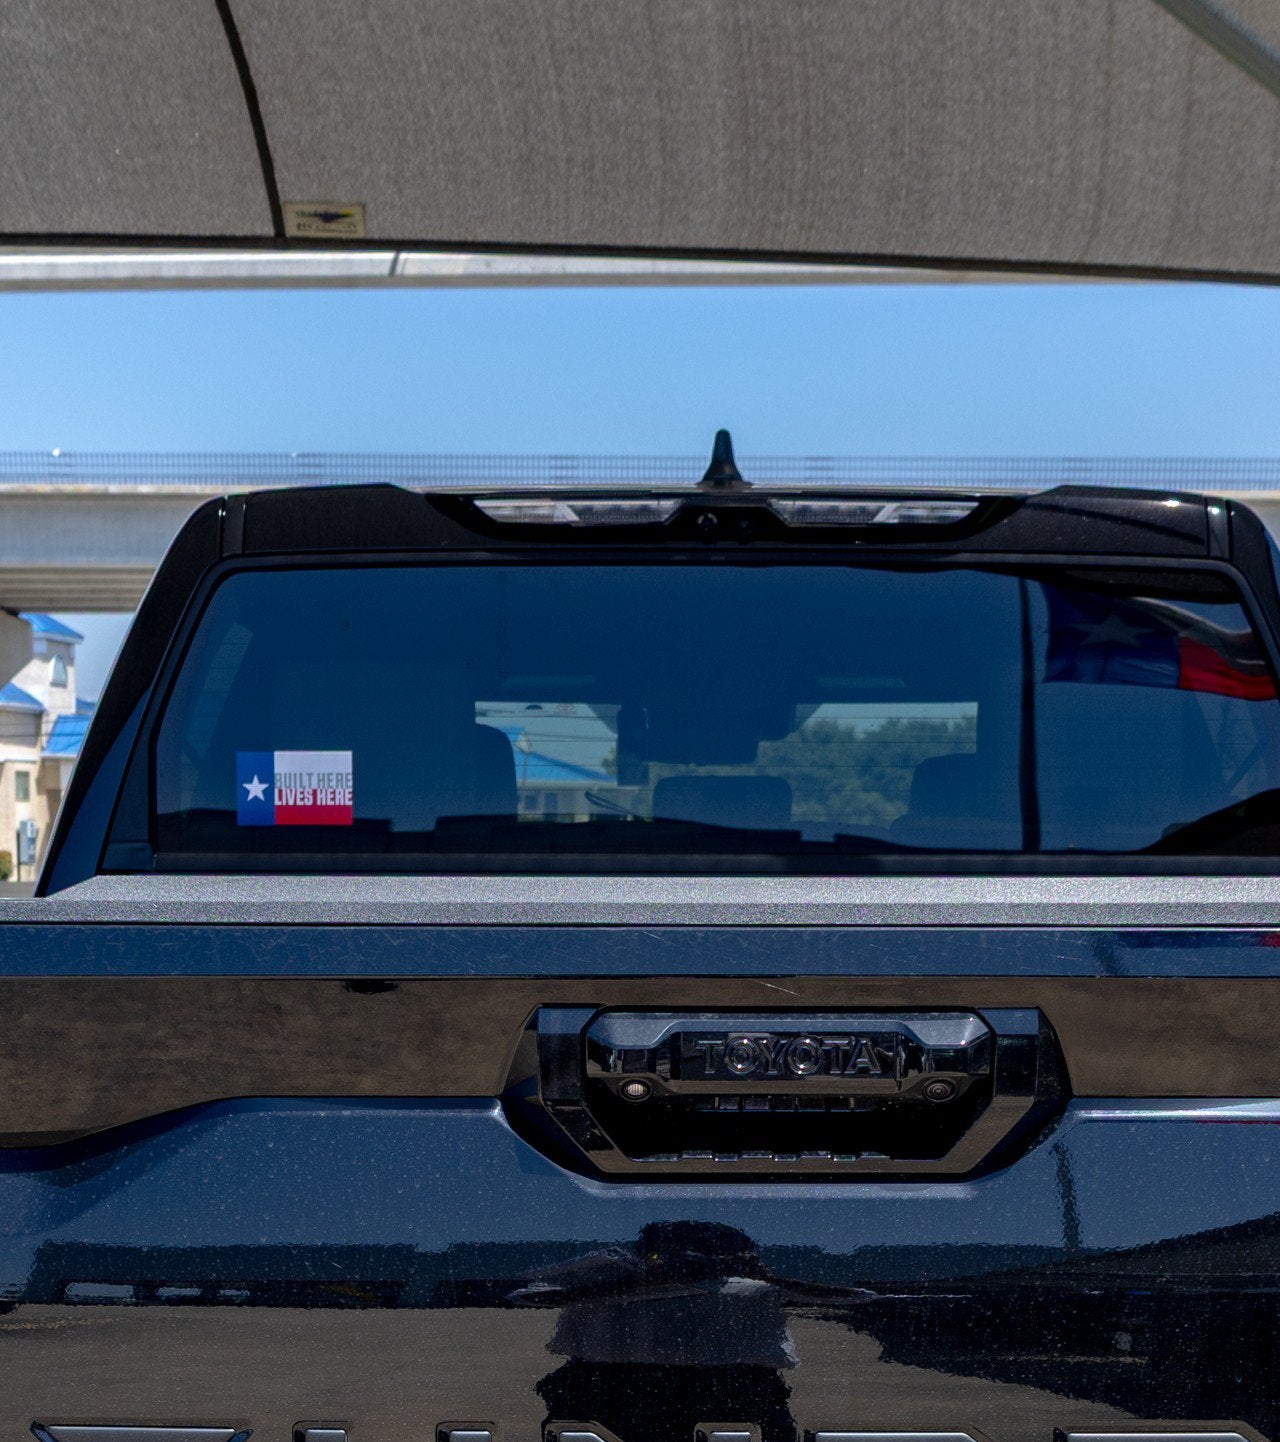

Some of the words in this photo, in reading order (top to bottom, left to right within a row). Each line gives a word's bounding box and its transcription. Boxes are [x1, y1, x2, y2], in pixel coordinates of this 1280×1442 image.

[275, 772, 313, 789] BUILT
[317, 772, 352, 789] HERE
[274, 788, 313, 806] LIVES
[317, 788, 352, 806] HERE
[694, 1035, 882, 1075] TOYOTA
